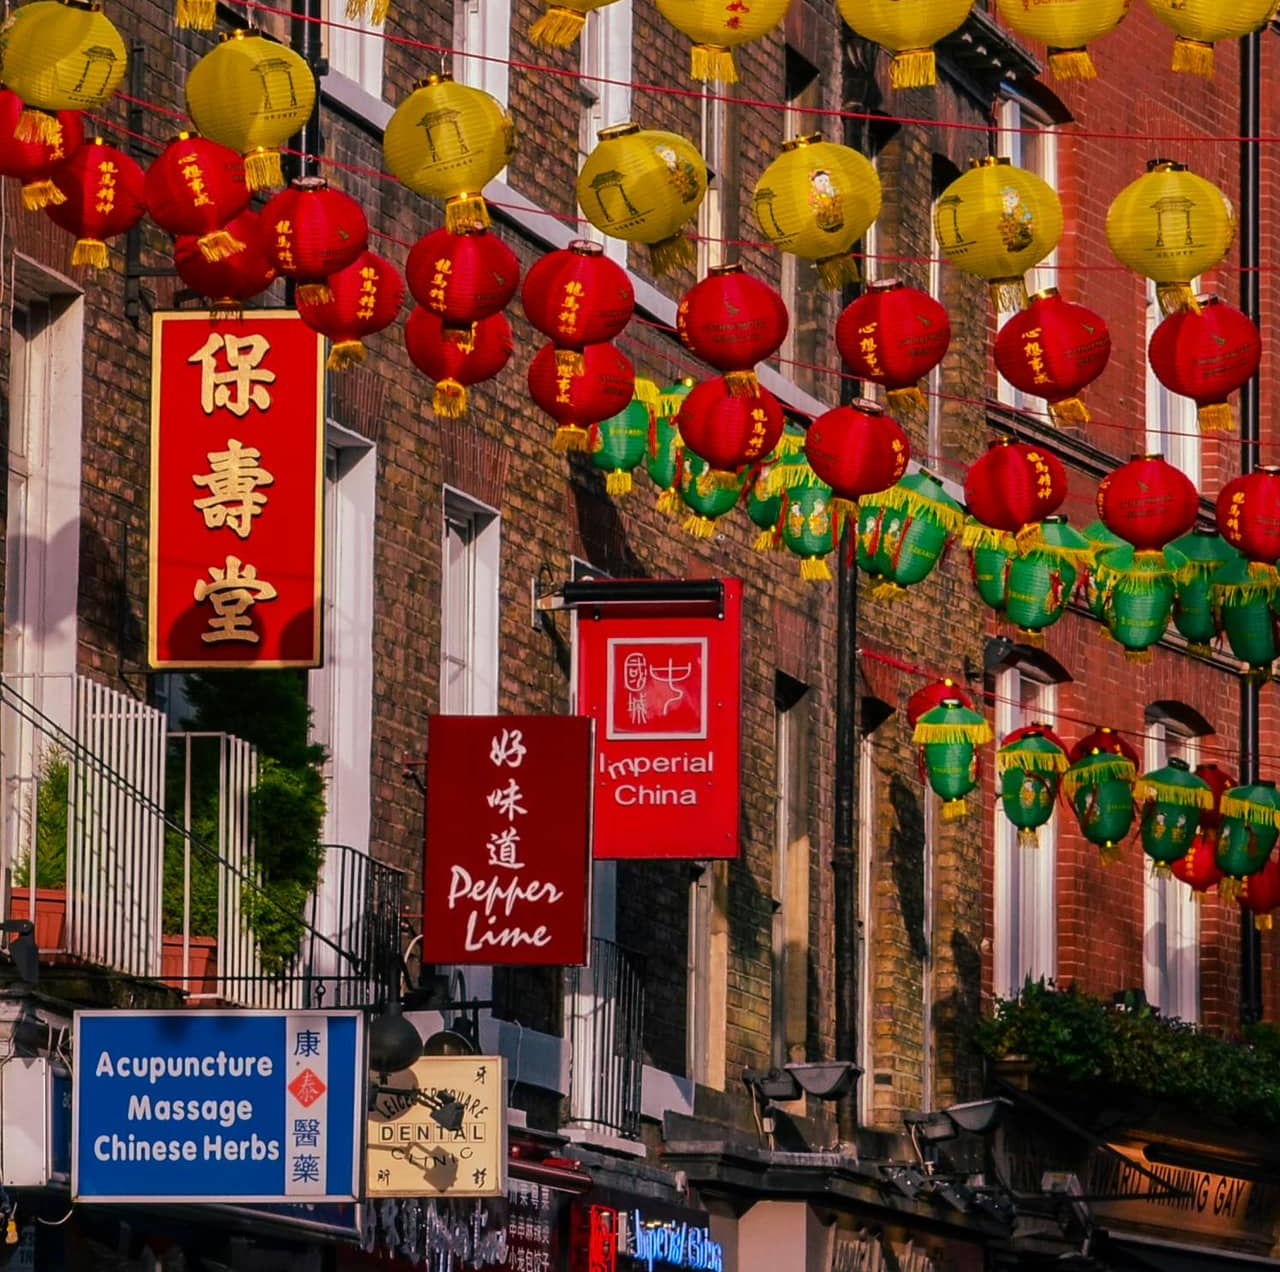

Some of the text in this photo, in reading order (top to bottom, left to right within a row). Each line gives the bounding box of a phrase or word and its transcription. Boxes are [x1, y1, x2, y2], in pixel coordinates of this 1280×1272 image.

[188, 332, 277, 643] 保壽堂
[600, 752, 713, 780] Imperial
[486, 728, 528, 868] 好味道
[615, 785, 697, 805] China
[448, 866, 563, 916] Pepper
[464, 911, 552, 952] Lime
[96, 1051, 273, 1084] Acupuncture
[128, 1095, 253, 1127] Massage
[94, 1134, 280, 1161] Chinese Herbs
[381, 1125, 483, 1140] DENTAL
[392, 1147, 473, 1166] CLINIC
[1213, 1177, 1247, 1218] GAY
